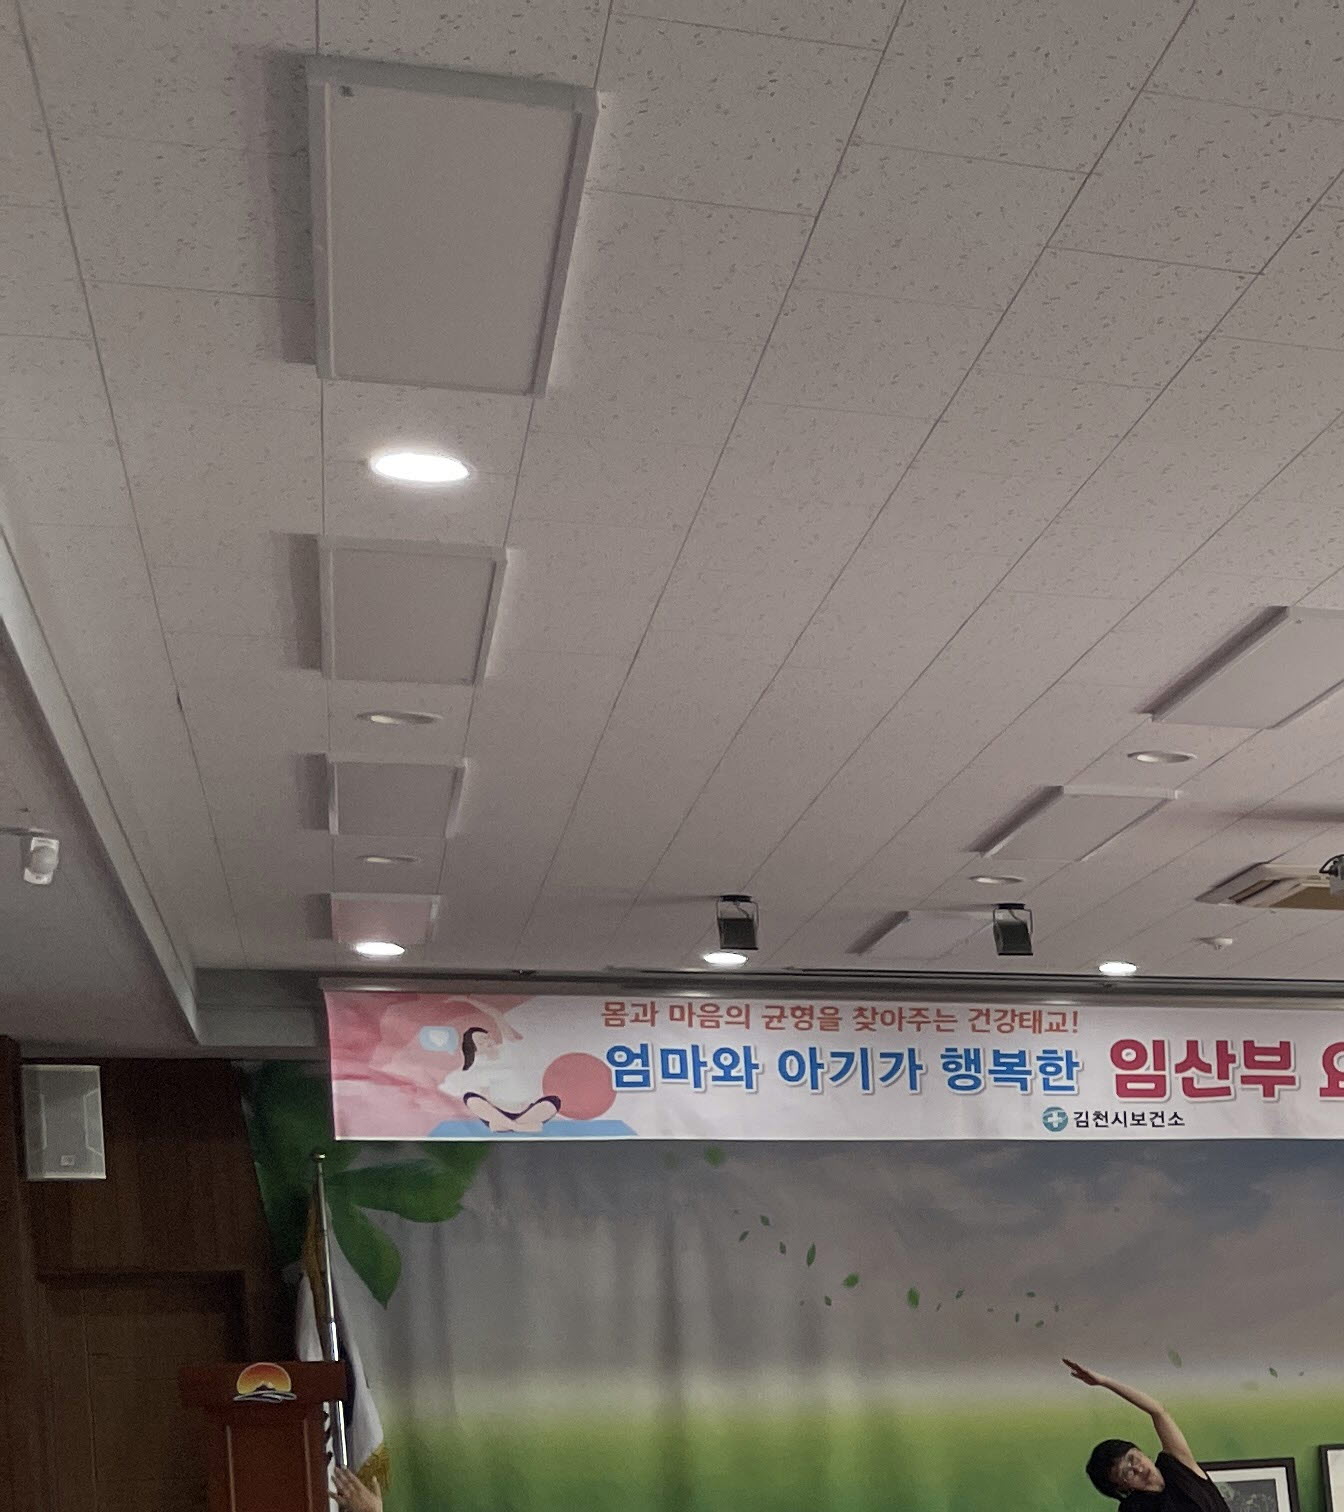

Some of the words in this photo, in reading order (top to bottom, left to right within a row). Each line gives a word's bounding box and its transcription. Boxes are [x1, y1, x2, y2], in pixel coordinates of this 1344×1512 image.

[601, 1001, 658, 1028] 몸과
[668, 1002, 750, 1029] 마음의
[761, 1004, 843, 1032] 균형을
[852, 1006, 958, 1033] 찾아주는
[967, 1008, 1078, 1034] 건강태교!
[606, 1043, 760, 1091] 엄마와
[778, 1047, 924, 1092] 아기가
[940, 1047, 1081, 1092] 행복한
[1109, 1039, 1296, 1099] 임산부
[1073, 1110, 1186, 1129] 김천시보건소
